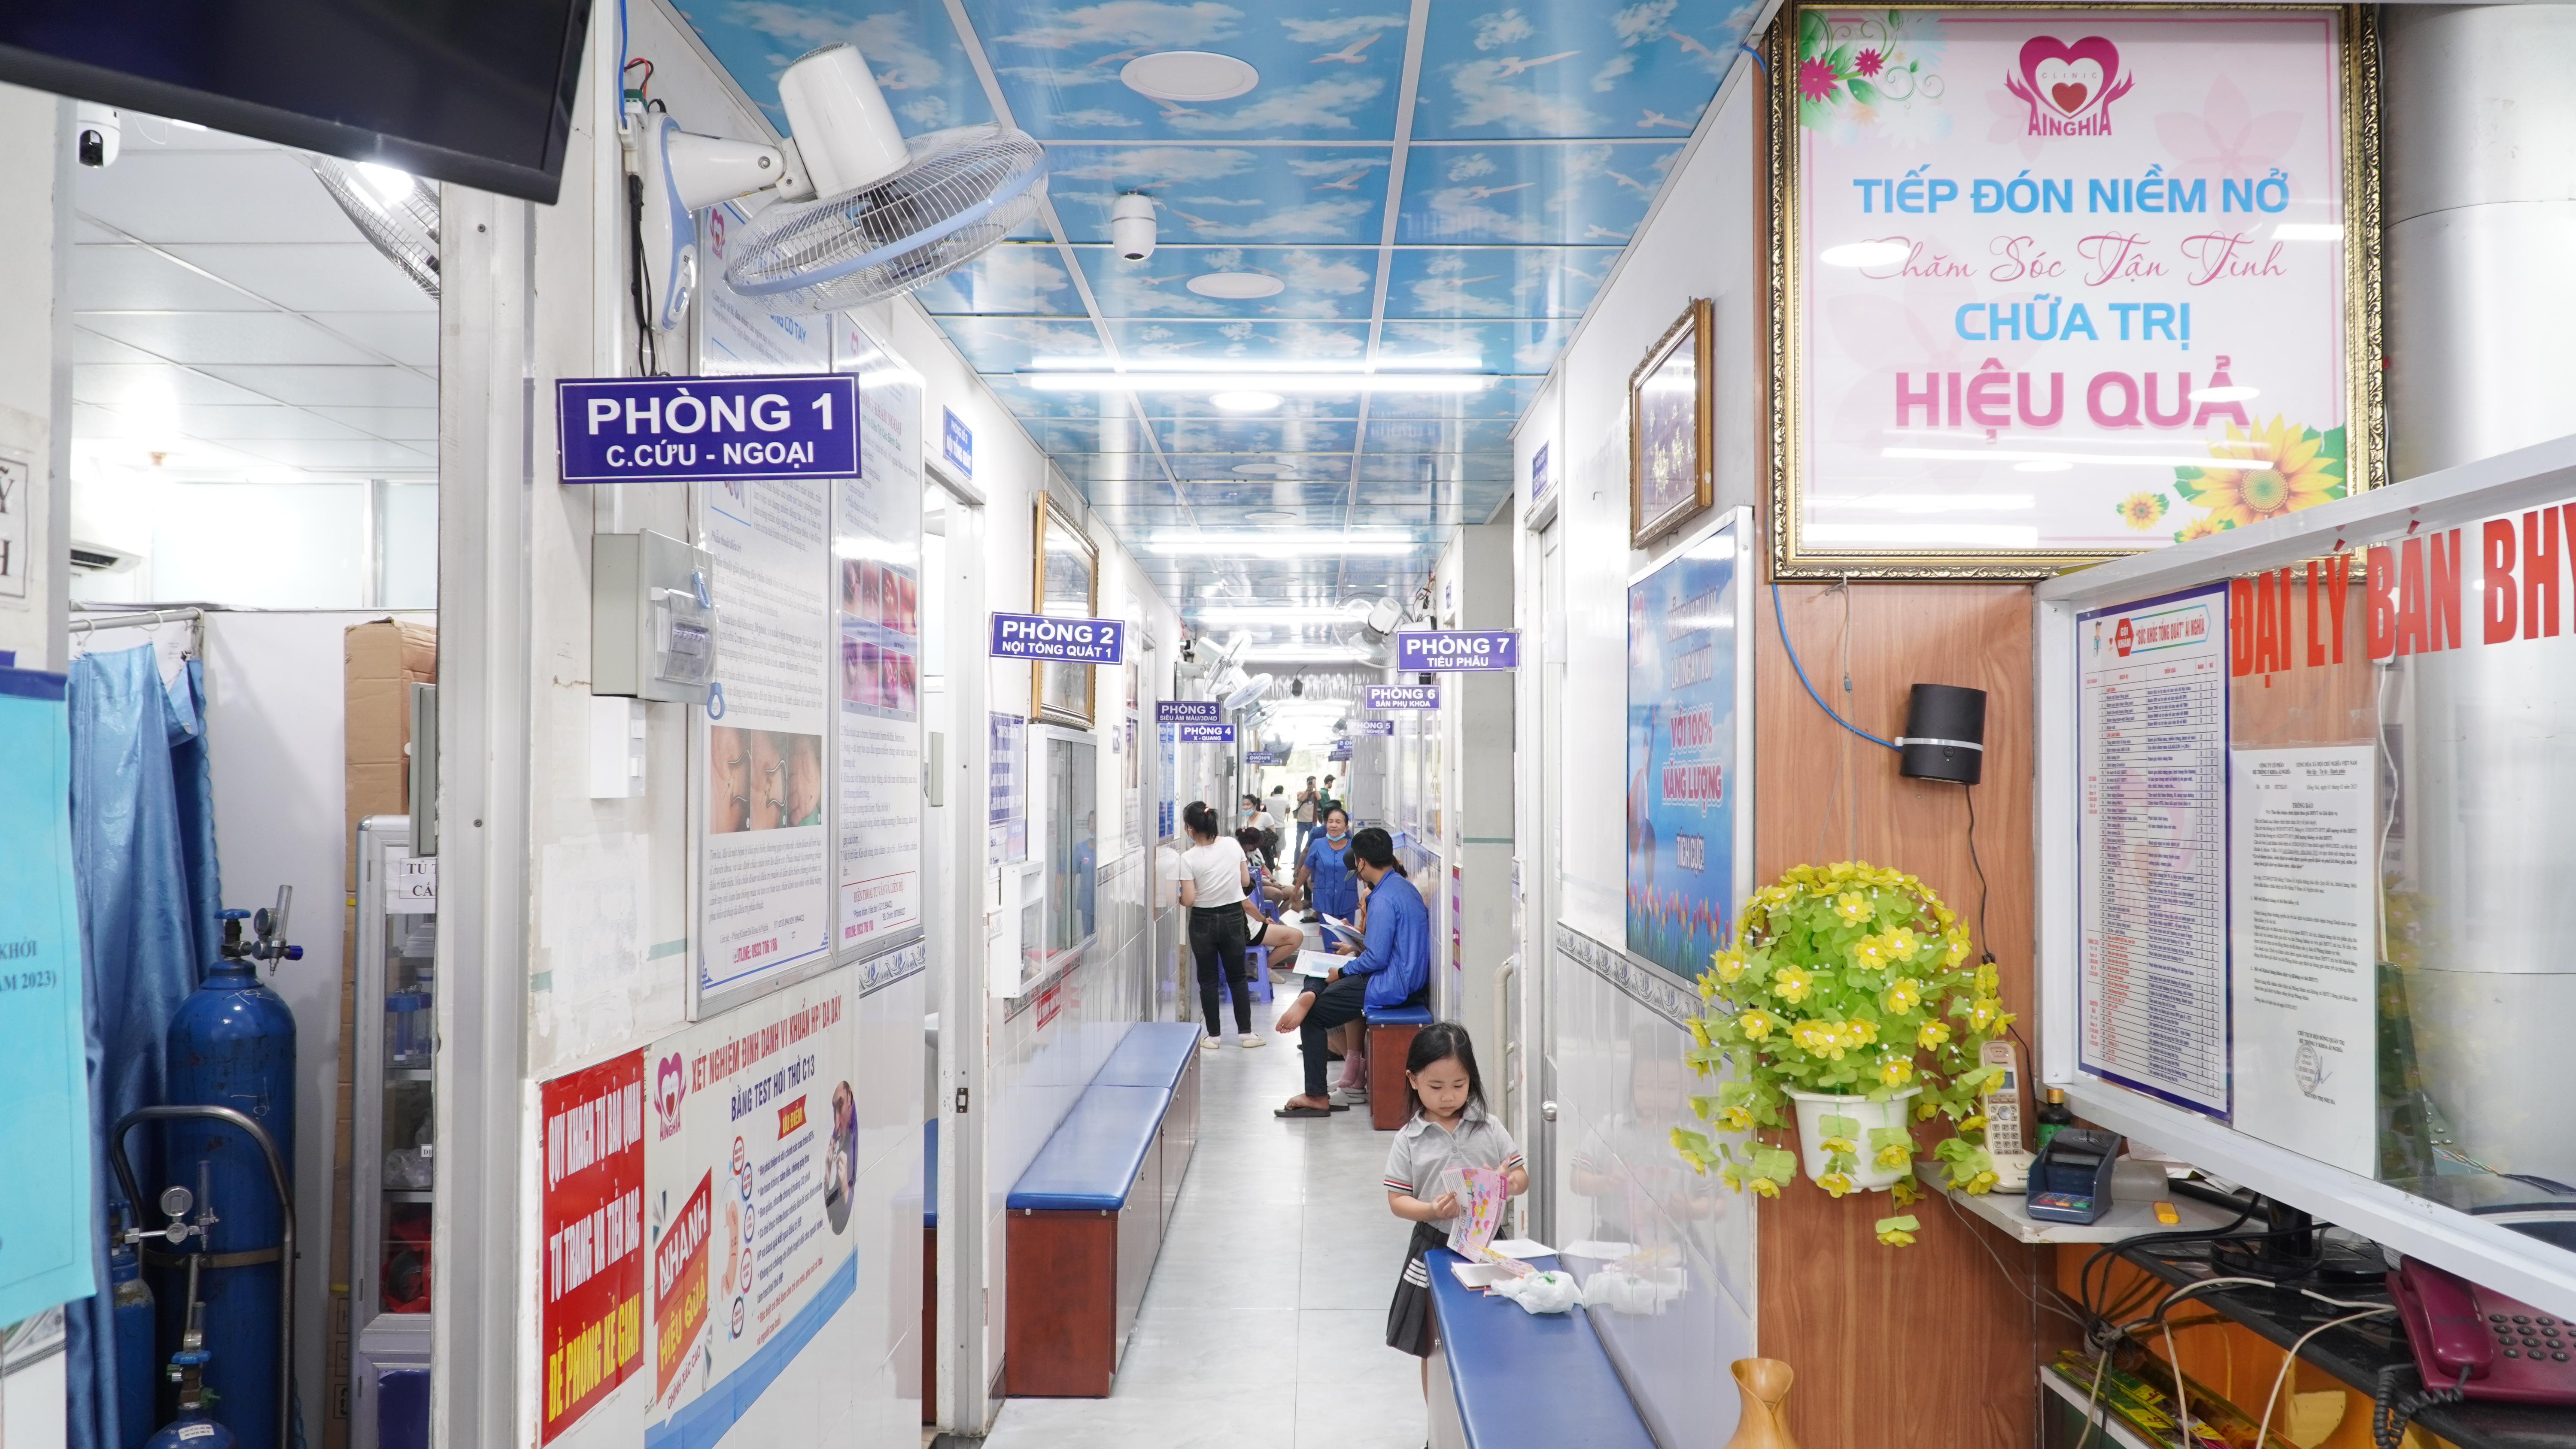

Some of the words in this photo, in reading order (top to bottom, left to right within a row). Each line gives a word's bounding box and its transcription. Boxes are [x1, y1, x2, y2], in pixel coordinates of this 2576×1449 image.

[2041, 70, 2098, 79] CLINIC
[2028, 108, 2112, 136] AINGHIA
[1853, 165, 1957, 214] TIẾP
[1970, 169, 2073, 214] ĐÓN
[2090, 164, 2206, 213] NIỀM
[2223, 168, 2290, 214] NỞ
[1989, 235, 2066, 284] Sóc
[2078, 230, 2168, 287] Tận
[2181, 230, 2287, 287] Tình
[1954, 294, 2099, 342] CHỮA
[2109, 302, 2191, 351] TRỊ
[587, 387, 791, 435] PHÒNG
[811, 392, 833, 430] 1
[1896, 357, 2065, 445] HIỆU
[2087, 355, 2251, 427] QUẢ
[606, 439, 696, 467] C.CỨU
[723, 441, 814, 468] NGOẠI
[2230, 567, 2292, 688] ĐẠI
[2307, 538, 2351, 668] LÝ
[2366, 520, 2461, 660] BÁN
[1002, 619, 1093, 644] PHÒNG
[1100, 627, 1114, 645] 2
[1406, 636, 1490, 655] PHÒNG
[1497, 638, 1510, 653] 7
[1002, 641, 1025, 655] NỘI
[1027, 641, 1063, 656] TỔNG
[1066, 643, 1103, 658] QUÁT
[1106, 648, 1112, 658] 1
[1427, 655, 1453, 667] TIỂU
[1456, 655, 1489, 667] PHẪU
[1371, 687, 1424, 699] PHÒNG
[1427, 689, 1436, 699] 6
[1375, 699, 1391, 707] SẢN
[1392, 700, 1408, 708] PHỤ
[1161, 703, 1206, 715] PHÒNG
[1209, 706, 1217, 715] 3
[1184, 725, 1223, 736] PHÒNG
[1224, 727, 1232, 735] 4
[1351, 721, 1383, 729] PHÒNG
[1670, 706, 1686, 749] VỚI
[1688, 709, 1713, 747] 100%
[1663, 759, 1687, 799] NĂNG
[1688, 764, 1722, 811] LƯỢNG
[1677, 827, 1690, 869] TÍCH
[407, 860, 427, 874] TỦ
[413, 882, 436, 896] CẤ
[752, 942, 762, 958] 0933
[21, 970, 58, 989] 2023)
[691, 1049, 707, 1094] XÉT
[709, 1035, 739, 1085] NGHIỆM
[741, 1031, 759, 1074] ĐỊNH
[761, 1022, 779, 1059] DANH
[781, 1018, 787, 1049] VI
[789, 997, 810, 1045] KHUẨN
[822, 999, 830, 1033] DẠ
[831, 990, 841, 1024] DÀY
[731, 1084, 752, 1123] BẰNG
[754, 1076, 772, 1109] TEST
[773, 1067, 786, 1098] HƠI
[787, 1055, 801, 1091] THỞ
[802, 1054, 815, 1081] C13
[548, 1101, 565, 1193] QUÝ
[567, 1094, 594, 1176] KHÁCH
[595, 1085, 606, 1172] TỰ
[607, 1076, 622, 1154] BẢO
[623, 1067, 641, 1154] QUẢN
[659, 1118, 681, 1142] AINGHIA
[550, 1220, 564, 1303] TƯ
[564, 1214, 592, 1295] TRANG
[594, 1197, 606, 1277] VÀ
[607, 1178, 623, 1267] TIỀN
[625, 1185, 640, 1263] BẠC
[658, 1190, 708, 1301] NHANH
[660, 1311, 682, 1373] HIỆU
[684, 1261, 707, 1329] QUẢ
[548, 1326, 564, 1423] ĐỀ
[565, 1321, 601, 1410] PHÒNG
[603, 1295, 616, 1380] KẺ
[617, 1292, 640, 1368] GIAN
[690, 1344, 701, 1373] CAO
